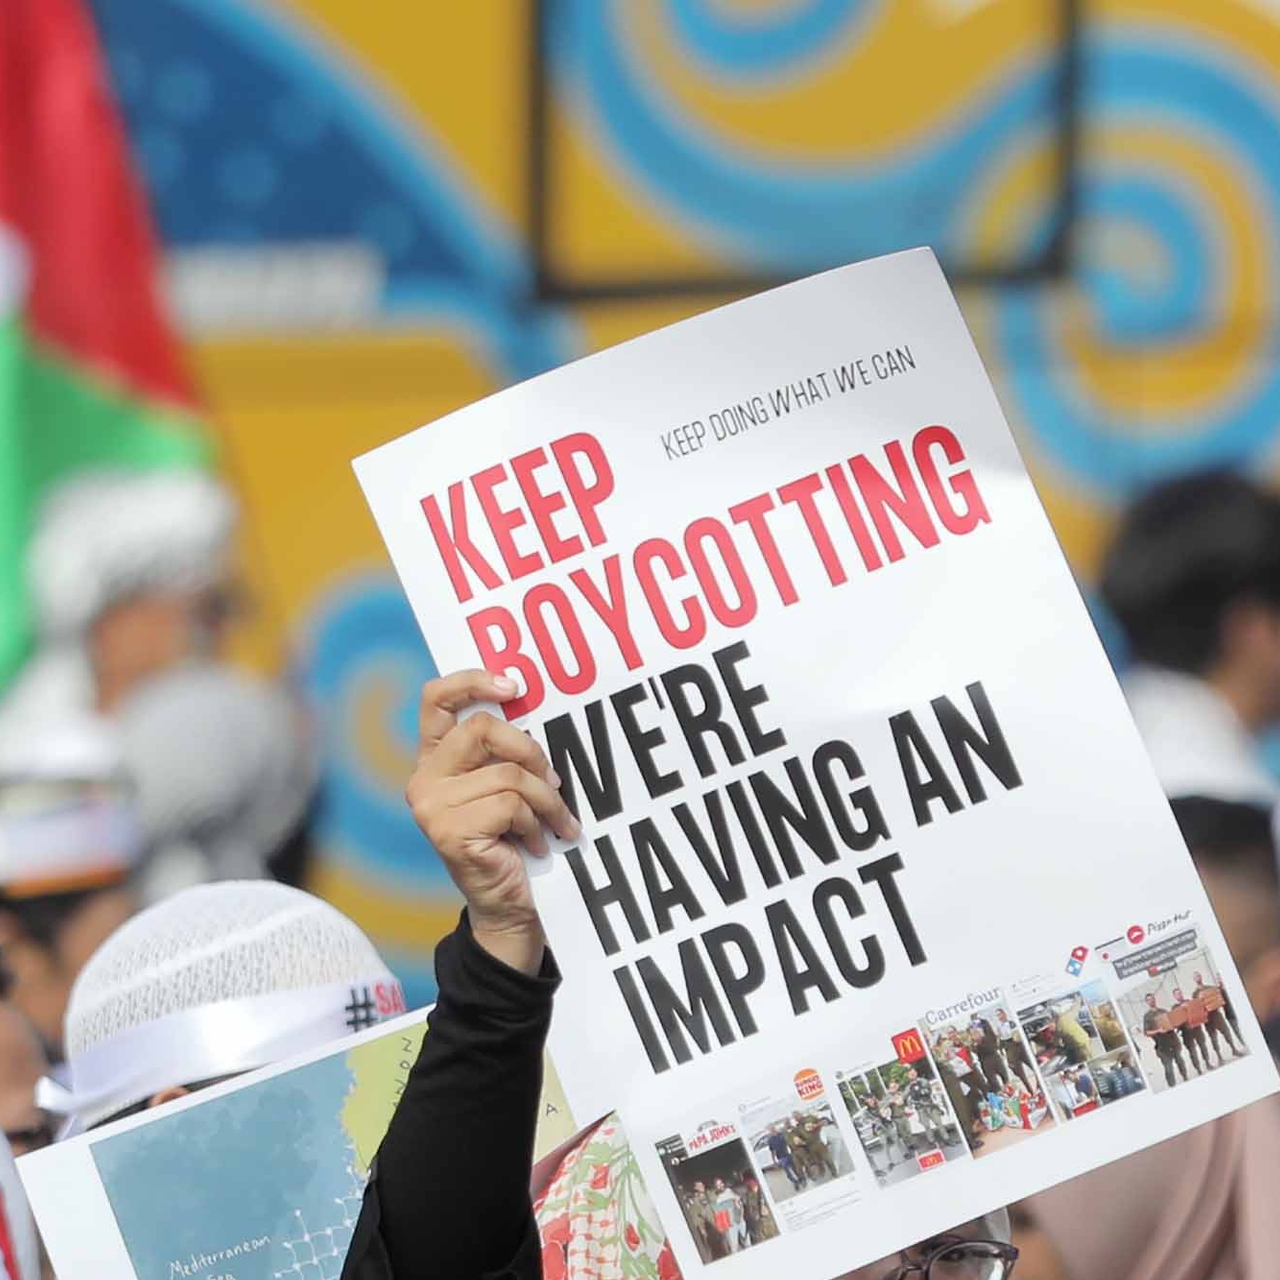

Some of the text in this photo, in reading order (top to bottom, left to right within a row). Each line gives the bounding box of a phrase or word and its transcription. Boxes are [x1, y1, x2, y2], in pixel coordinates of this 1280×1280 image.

[660, 345, 916, 461] KEEP DOING WHAT WE CAN
[420, 432, 614, 604] KEEP
[466, 425, 992, 722] BOYCOTTING
[524, 640, 787, 838] WE'RE
[563, 680, 1024, 957] HAVING AN
[613, 852, 927, 1075] IMPACT
[925, 986, 1001, 1026] Carrefour
[798, 1080, 824, 1097] KING
[169, 1235, 271, 1280] Mediterranean
